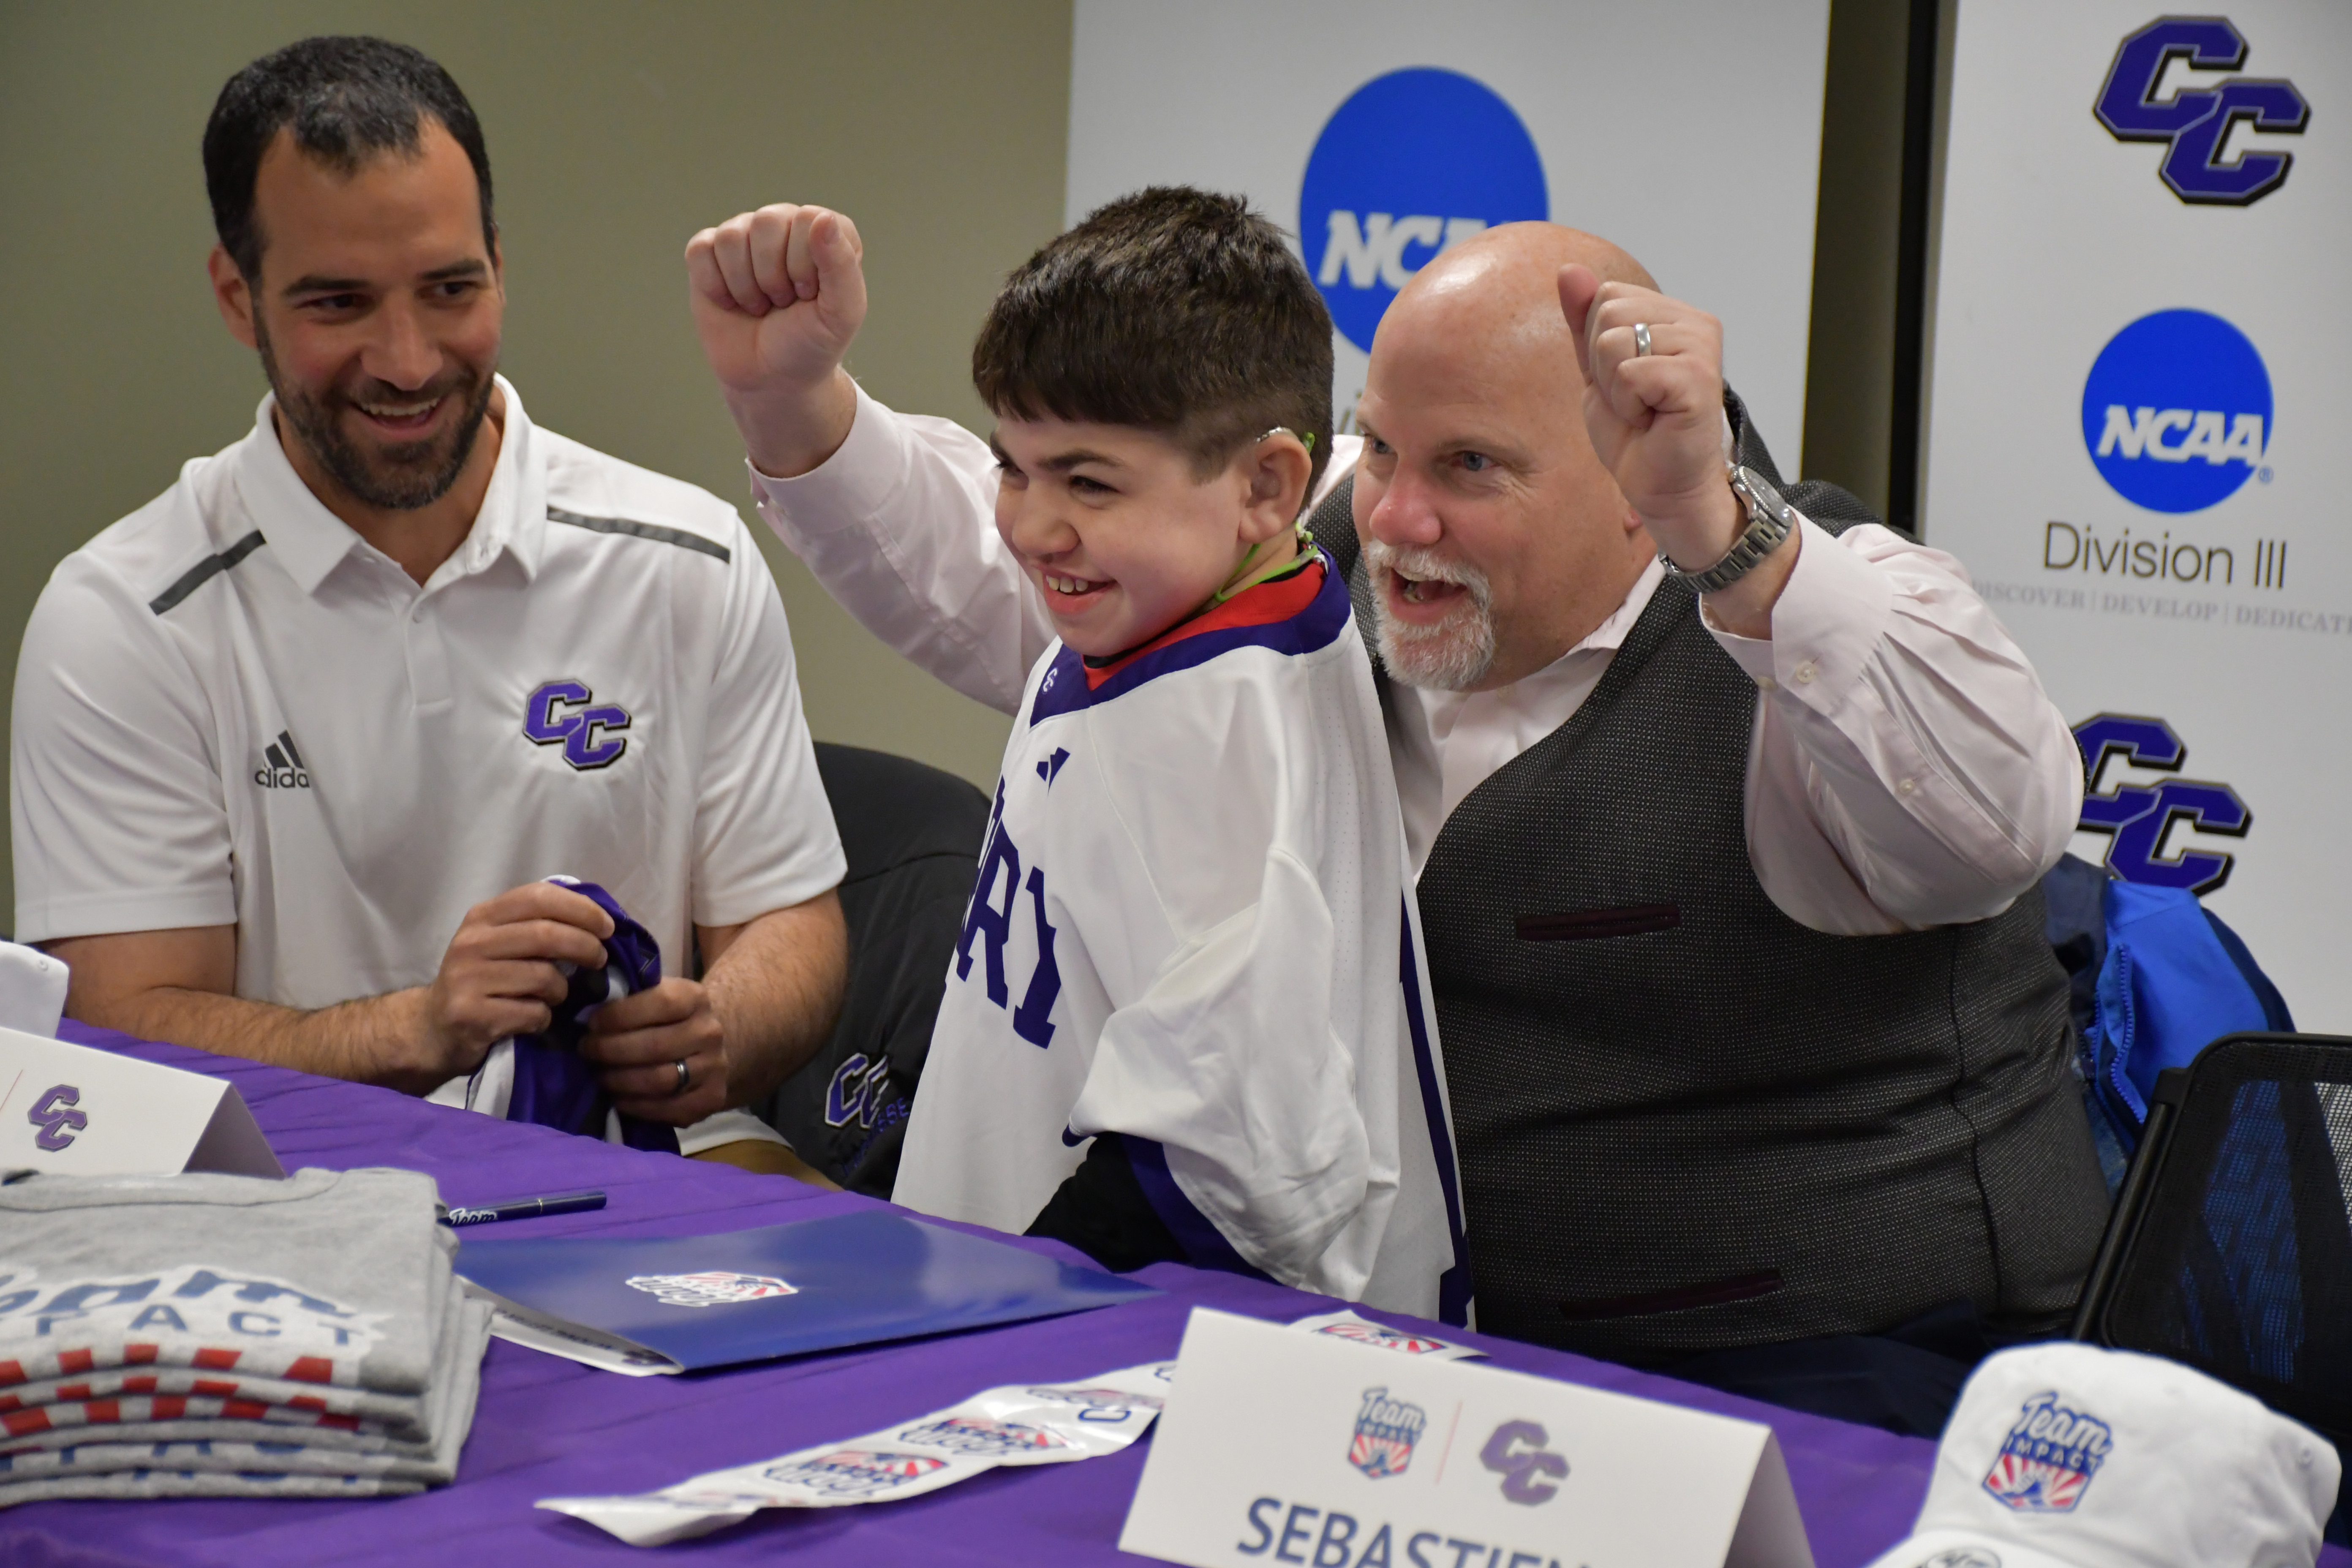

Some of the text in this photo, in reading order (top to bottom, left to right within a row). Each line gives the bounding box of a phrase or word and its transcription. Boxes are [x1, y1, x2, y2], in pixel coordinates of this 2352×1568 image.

[2093, 14, 2312, 207] CC
[1318, 209, 1514, 291] NC
[2096, 404, 2264, 468] NCAA
[2043, 521, 2288, 590] Division III
[2103, 593, 2219, 622] DEVELOP
[522, 678, 632, 772] CC
[27, 1084, 87, 1152] CC
[2012, 1391, 2113, 1456] Team
[1479, 1420, 1571, 1507] CC
[1237, 1496, 1592, 1568] SEBAST
